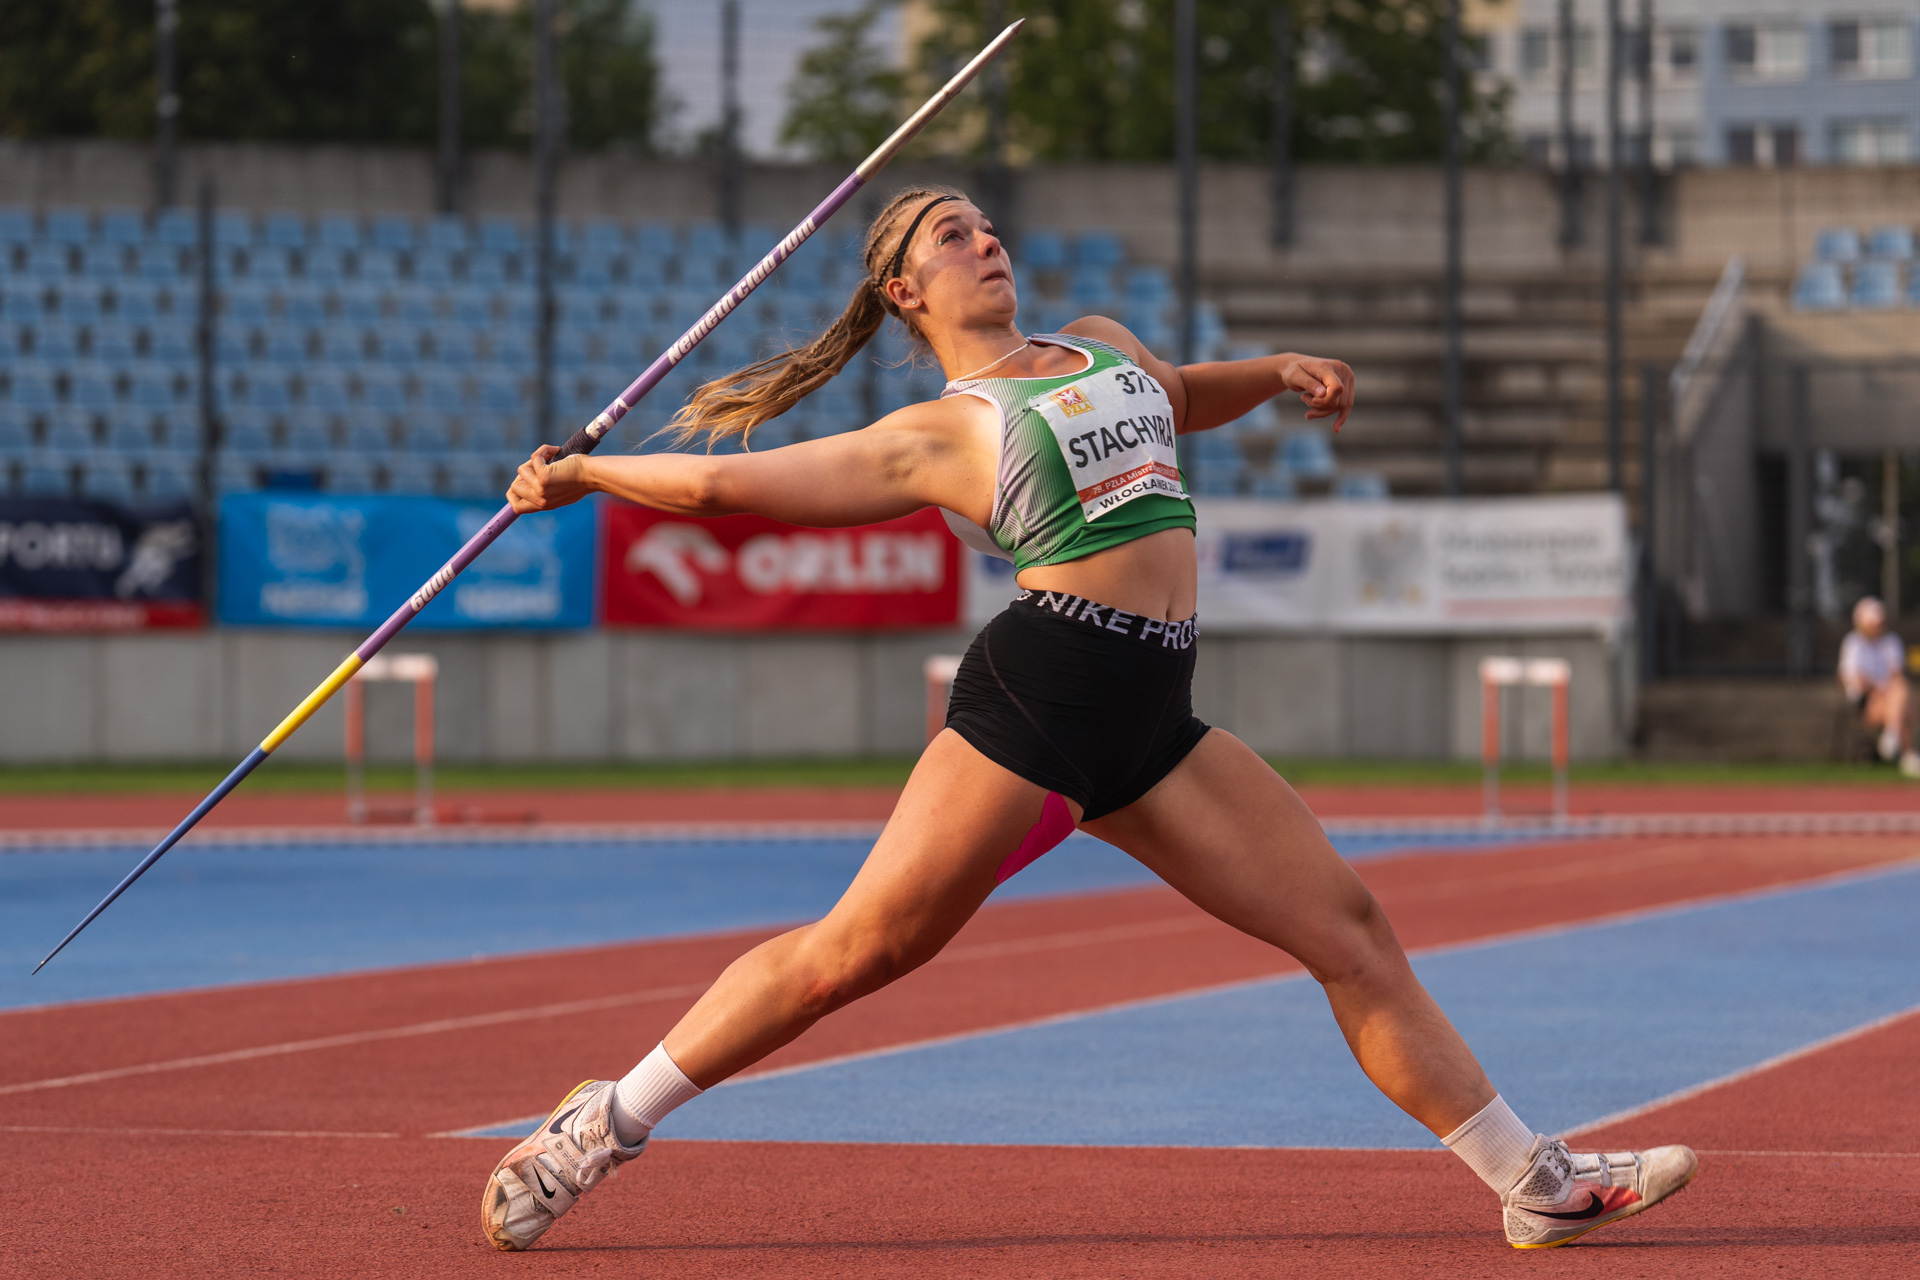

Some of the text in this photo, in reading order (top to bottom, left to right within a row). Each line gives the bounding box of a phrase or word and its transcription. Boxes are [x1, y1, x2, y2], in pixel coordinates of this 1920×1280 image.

[667, 293, 737, 365] Nemeth
[776, 217, 817, 260] 70m
[1115, 371, 1160, 394] 371
[1068, 415, 1174, 468] STACHYRA
[1105, 477, 1127, 490] PZLA
[410, 563, 456, 612] 600g
[739, 533, 945, 593] ORLEN
[1037, 590, 1137, 635] NIKE
[1139, 616, 1193, 650] PRO
